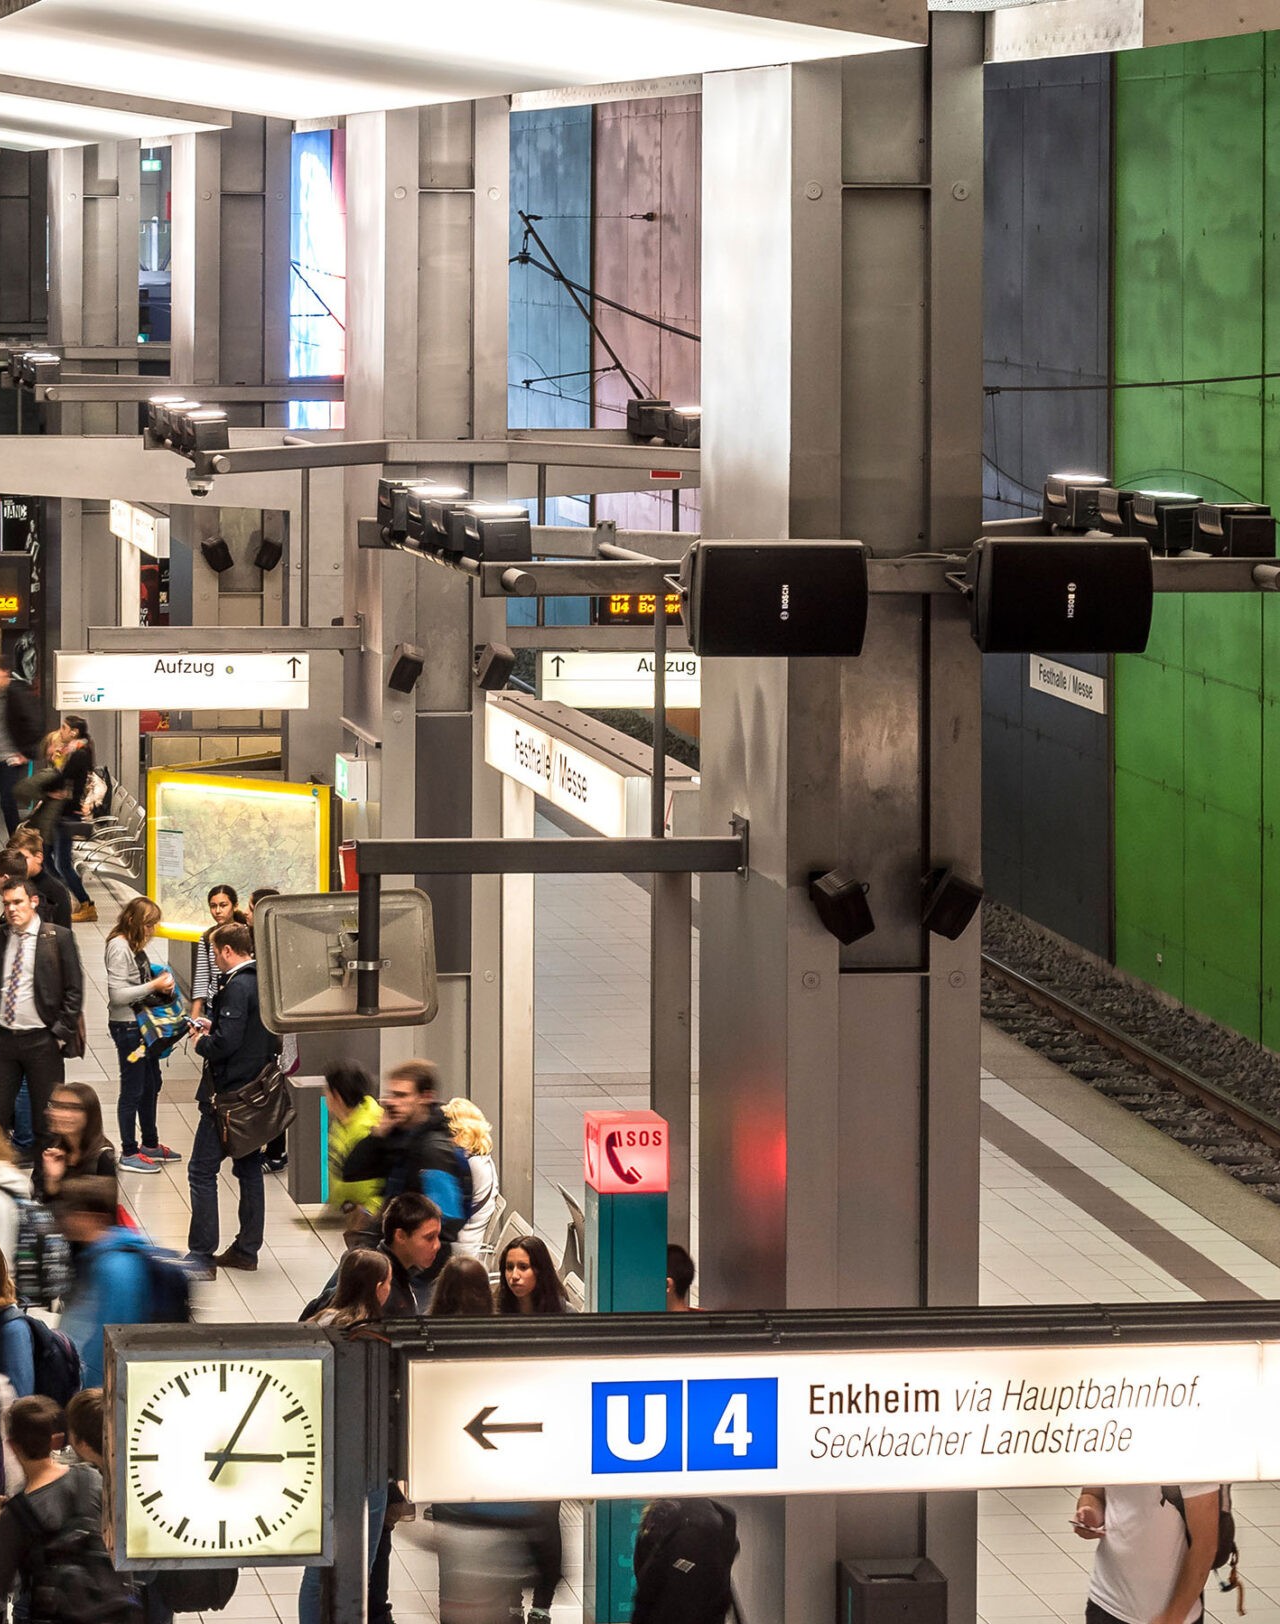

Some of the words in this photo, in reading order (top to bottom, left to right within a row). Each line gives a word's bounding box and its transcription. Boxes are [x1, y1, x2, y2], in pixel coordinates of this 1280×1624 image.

[610, 602, 630, 613] U4
[154, 659, 215, 677] Aufzug
[637, 657, 697, 676] Auzug
[1039, 663, 1066, 690] Festhalle
[1072, 675, 1093, 700] Messe
[515, 729, 551, 780] Festhalle
[558, 753, 588, 803] Messe
[626, 1130, 662, 1147] SOS
[606, 1393, 667, 1462] U
[713, 1393, 753, 1457] 4
[808, 1382, 941, 1415] Enkheim
[954, 1380, 992, 1413] via
[810, 1425, 973, 1459] Seckbacher
[980, 1419, 1133, 1455] Landstraße
